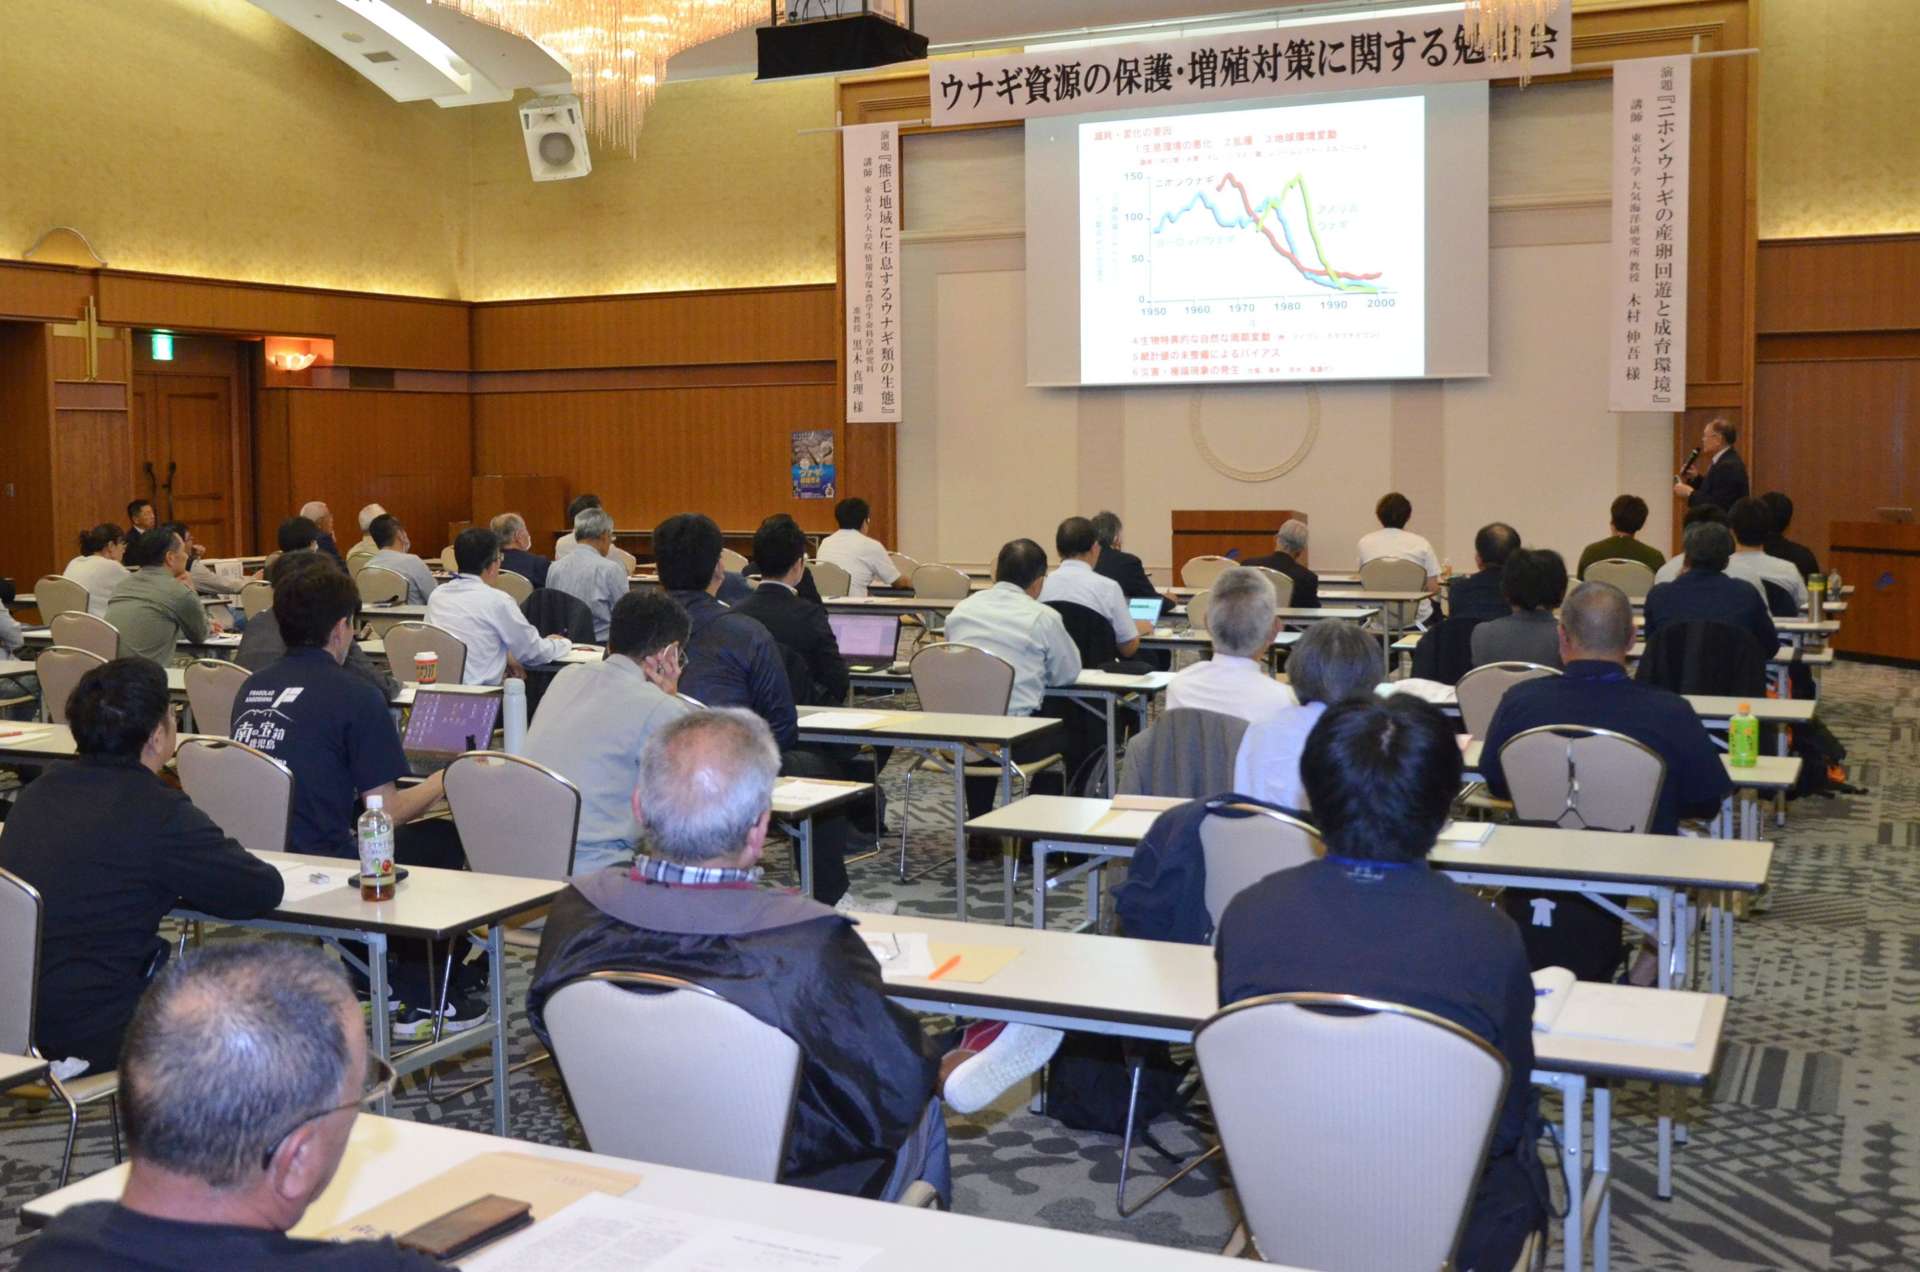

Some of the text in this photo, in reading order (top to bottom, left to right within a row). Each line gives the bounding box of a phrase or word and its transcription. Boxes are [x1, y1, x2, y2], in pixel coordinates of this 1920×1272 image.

[941, 24, 1559, 110] ウナギ資源の保護・増殖対策に関する勉会
[1124, 172, 1143, 181] 150
[1124, 213, 1143, 222] 100
[1132, 254, 1145, 264] 50
[1141, 298, 1396, 317] 1950 1960 1970 1980 1990 2000
